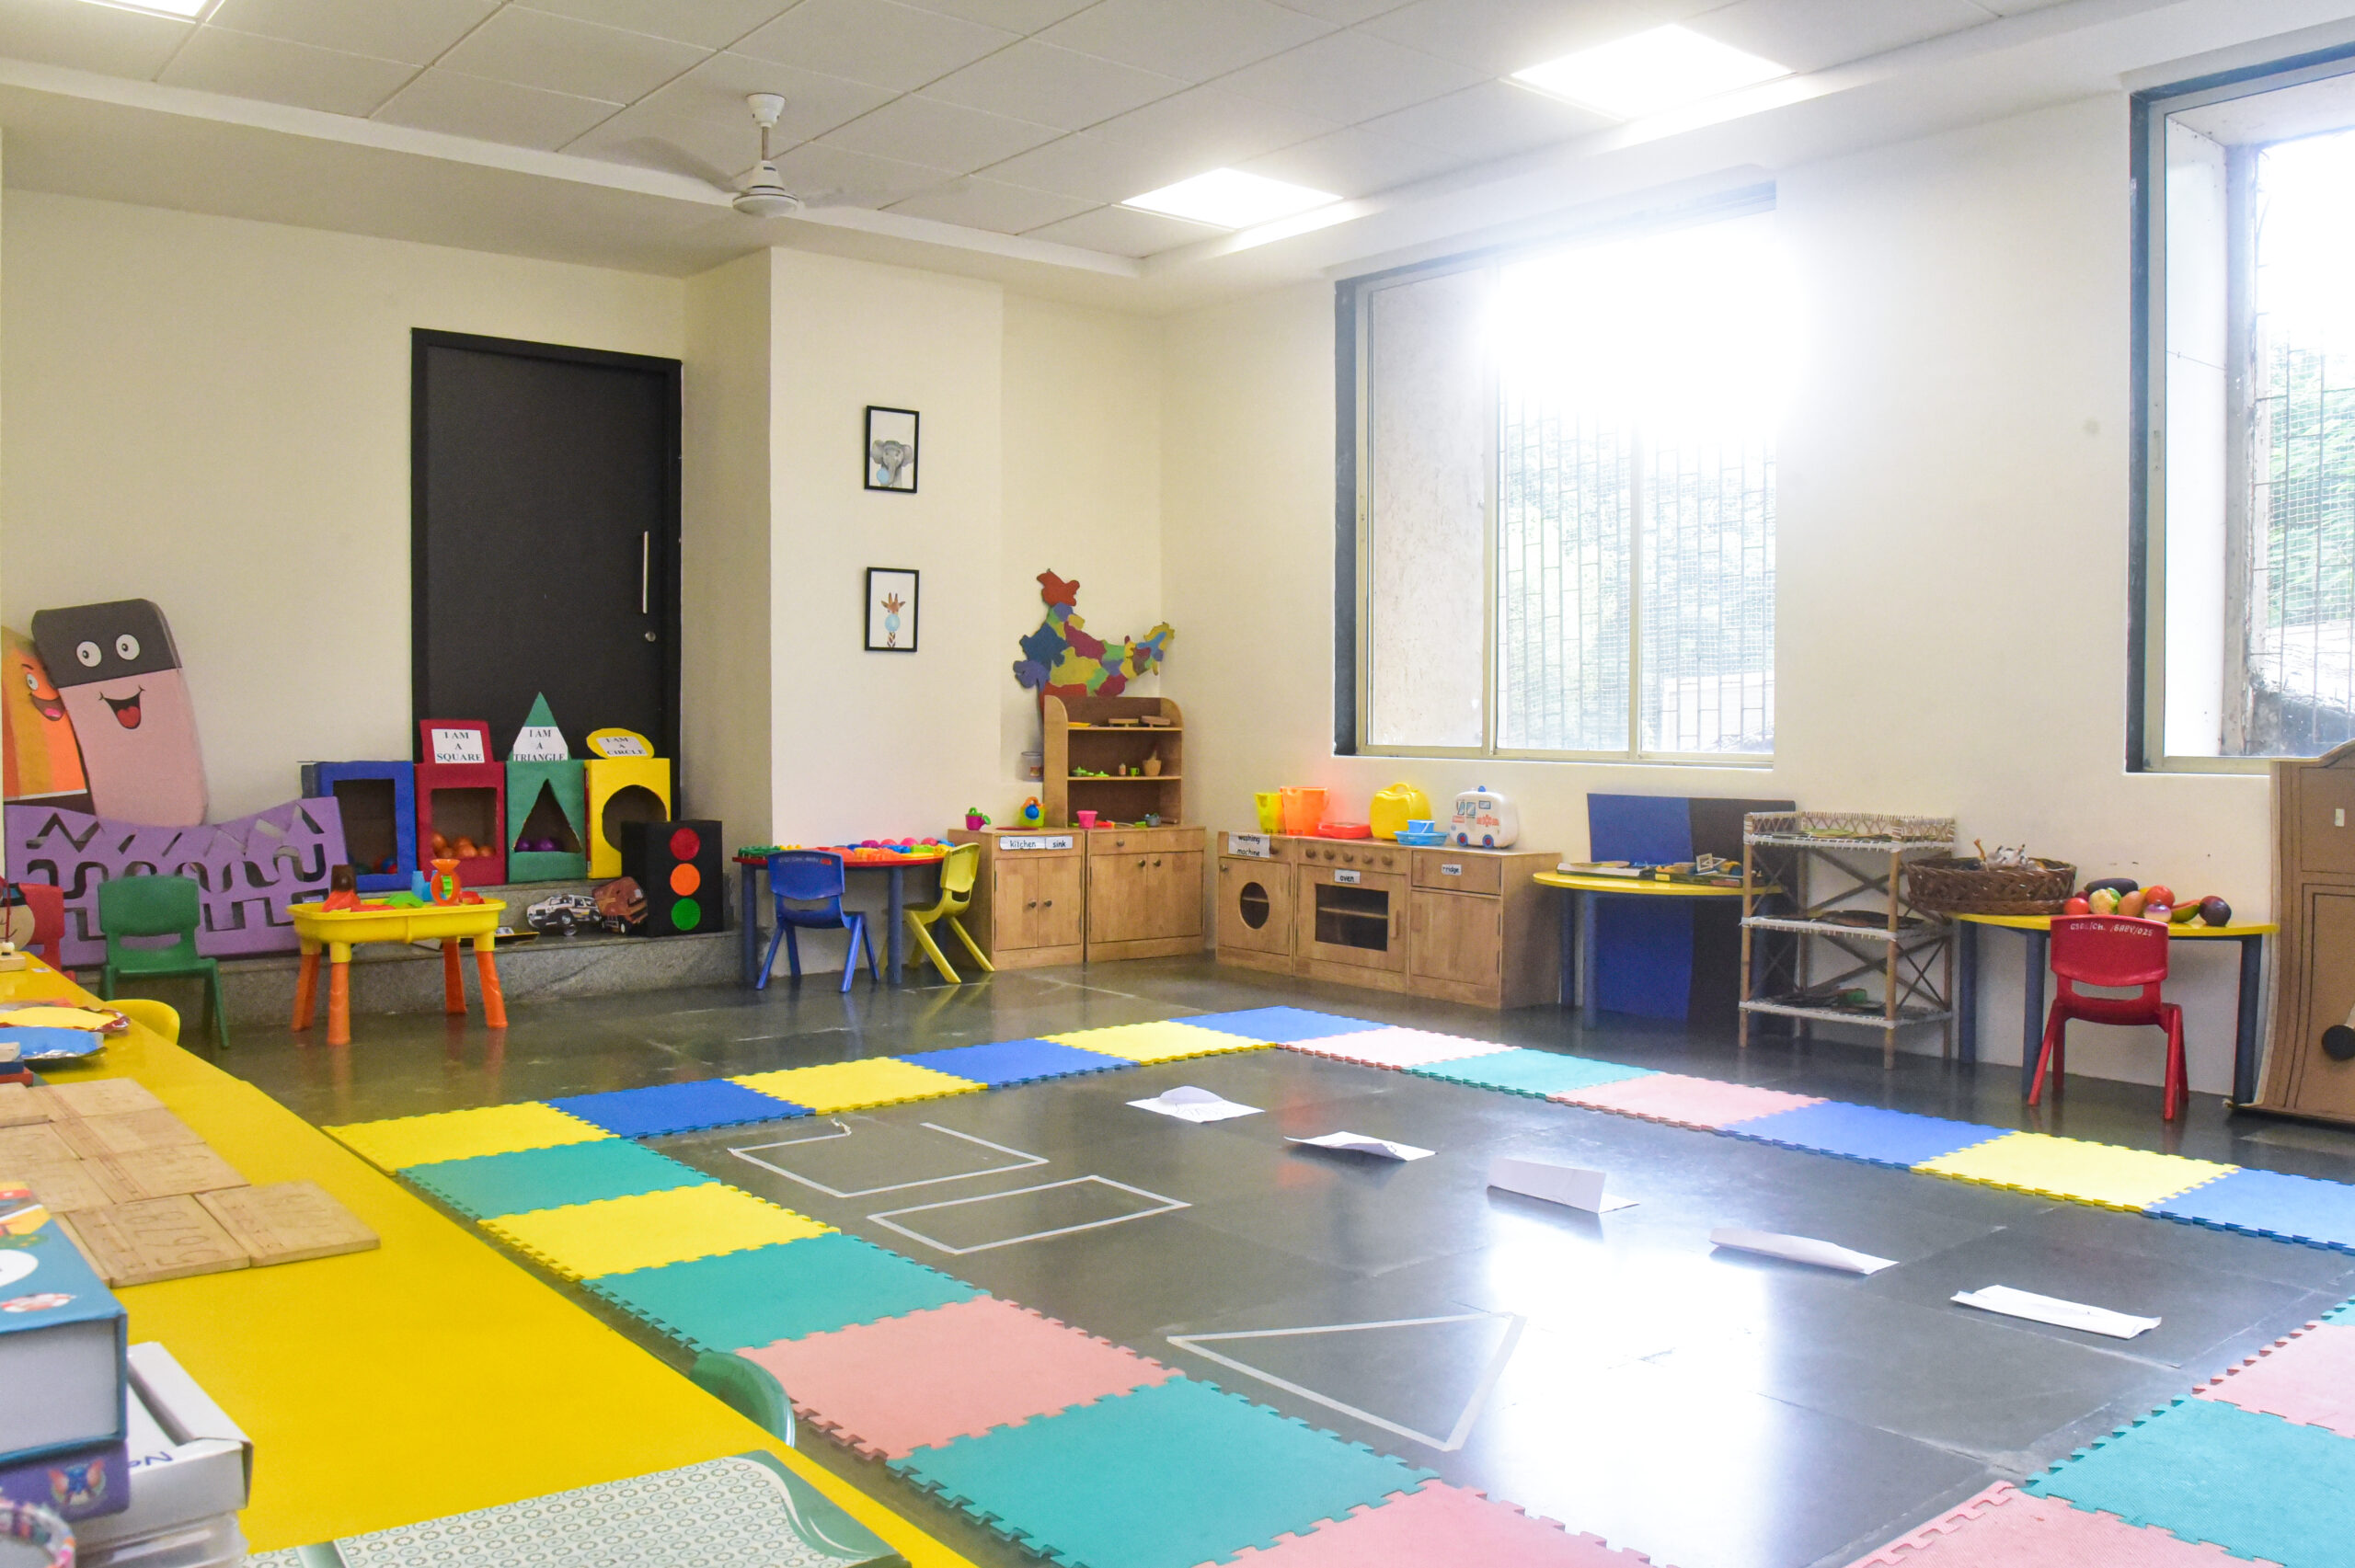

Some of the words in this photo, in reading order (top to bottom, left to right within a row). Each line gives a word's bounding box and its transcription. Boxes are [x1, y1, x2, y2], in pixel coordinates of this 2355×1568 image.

[452, 731, 469, 739] AM
[535, 729, 551, 738] AM
[437, 753, 483, 762] SQUARE
[514, 753, 565, 761] TRIANGLE
[1009, 840, 1037, 848] kitchen
[1052, 840, 1066, 848] sink
[1236, 848, 1260, 856] machine
[1339, 875, 1355, 883] oven
